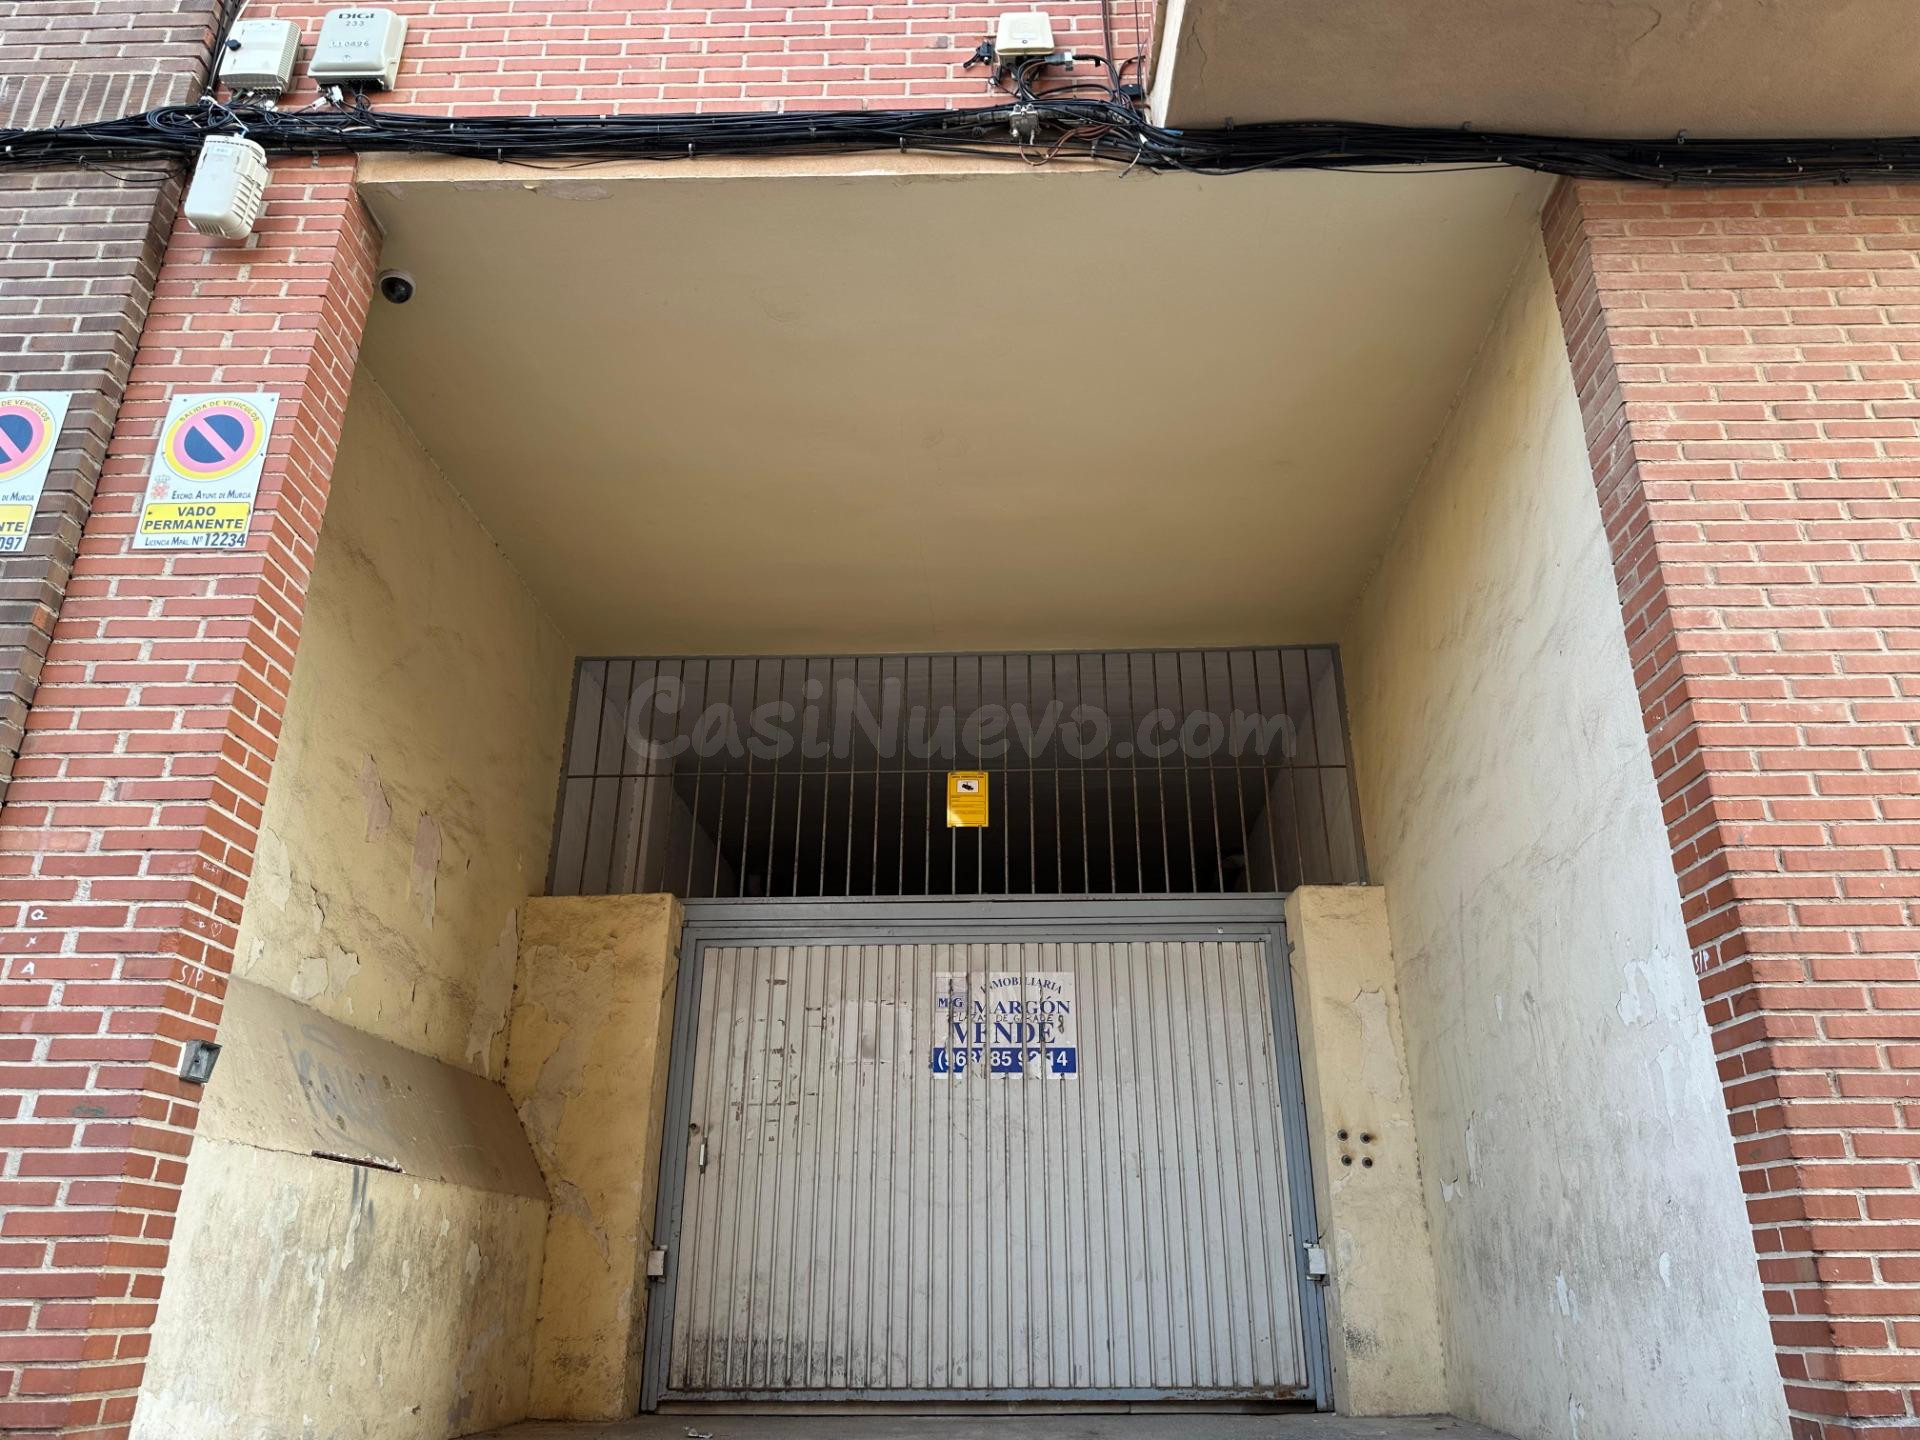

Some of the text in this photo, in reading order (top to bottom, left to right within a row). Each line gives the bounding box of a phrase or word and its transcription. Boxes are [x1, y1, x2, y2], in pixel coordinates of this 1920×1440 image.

[179, 404, 208, 421] SALIDA
[223, 400, 260, 422] VEHICULOS
[177, 506, 216, 517] VADO
[144, 518, 244, 530] PERMANENTE
[204, 532, 246, 547] 12234
[980, 976, 1063, 994] IMOBILIARIA
[952, 1021, 1056, 1044] VENDE
[991, 1050, 1012, 1067] 85
